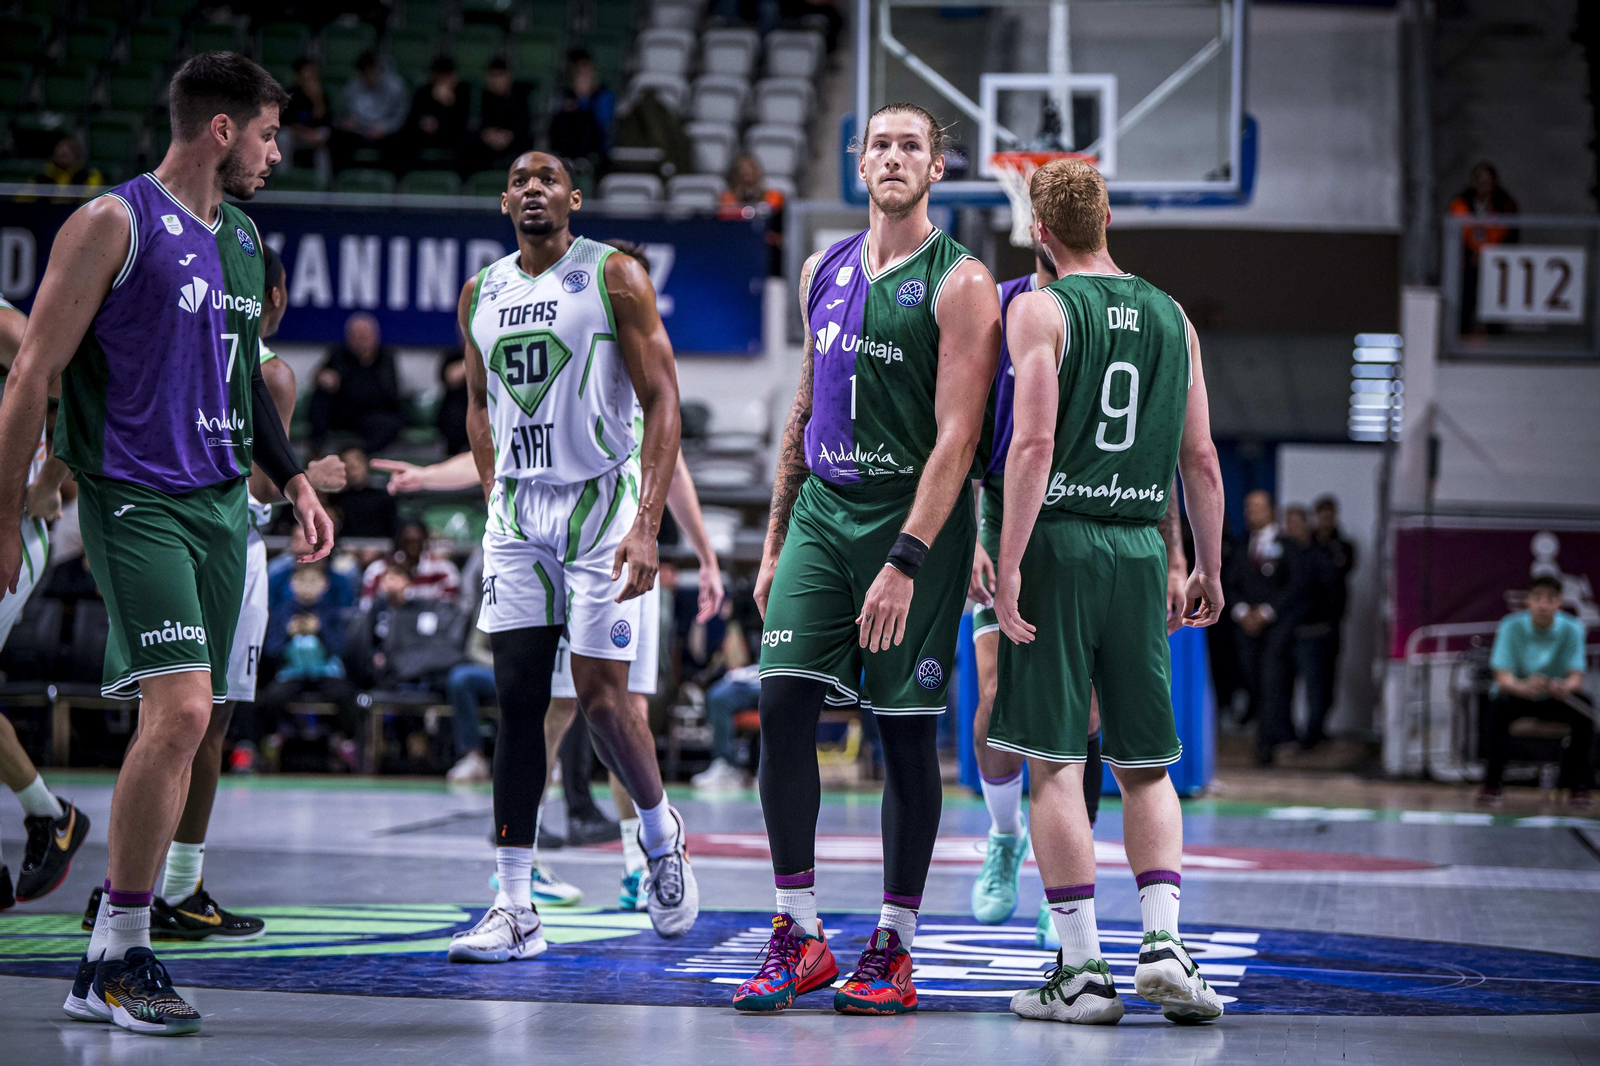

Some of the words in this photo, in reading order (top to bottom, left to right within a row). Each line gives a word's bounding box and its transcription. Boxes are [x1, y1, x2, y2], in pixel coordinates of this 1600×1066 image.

[1492, 256, 1574, 310] 112
[498, 299, 558, 328] TOFAŞ
[1107, 302, 1140, 333] DÍAZ
[220, 333, 239, 383] 7
[503, 341, 549, 386] 50
[841, 333, 904, 364] Unicaja
[849, 374, 857, 420] 1
[1095, 361, 1140, 452] 9
[510, 422, 554, 470] FIAT
[818, 442, 900, 467] Andalucía
